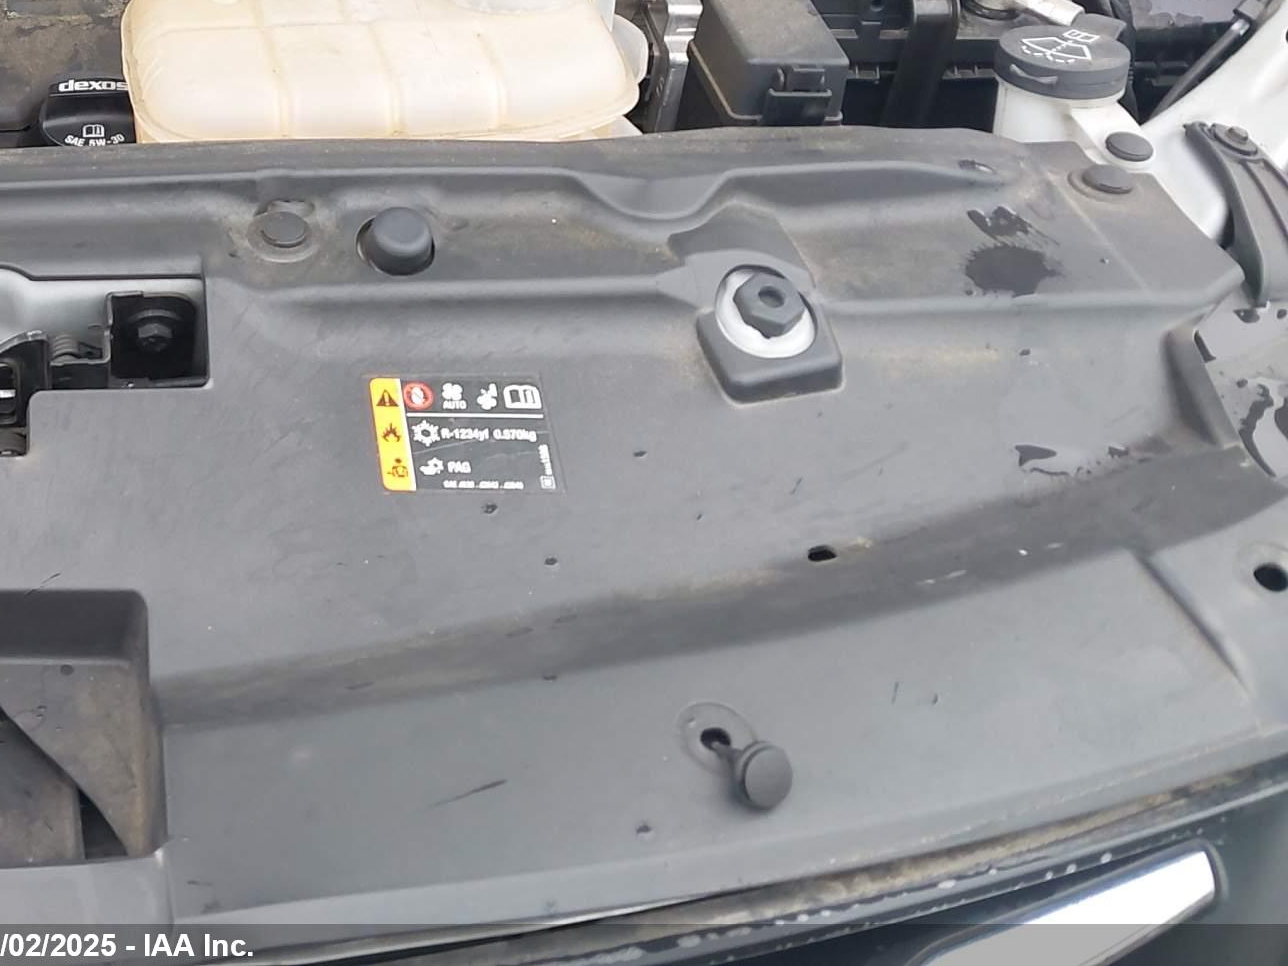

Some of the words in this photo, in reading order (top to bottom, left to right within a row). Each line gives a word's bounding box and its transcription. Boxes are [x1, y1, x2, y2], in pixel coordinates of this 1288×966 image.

[58, 79, 129, 92] dexos
[64, 134, 85, 147] SAE
[442, 399, 467, 410] AUTO
[447, 461, 472, 474] PAG
